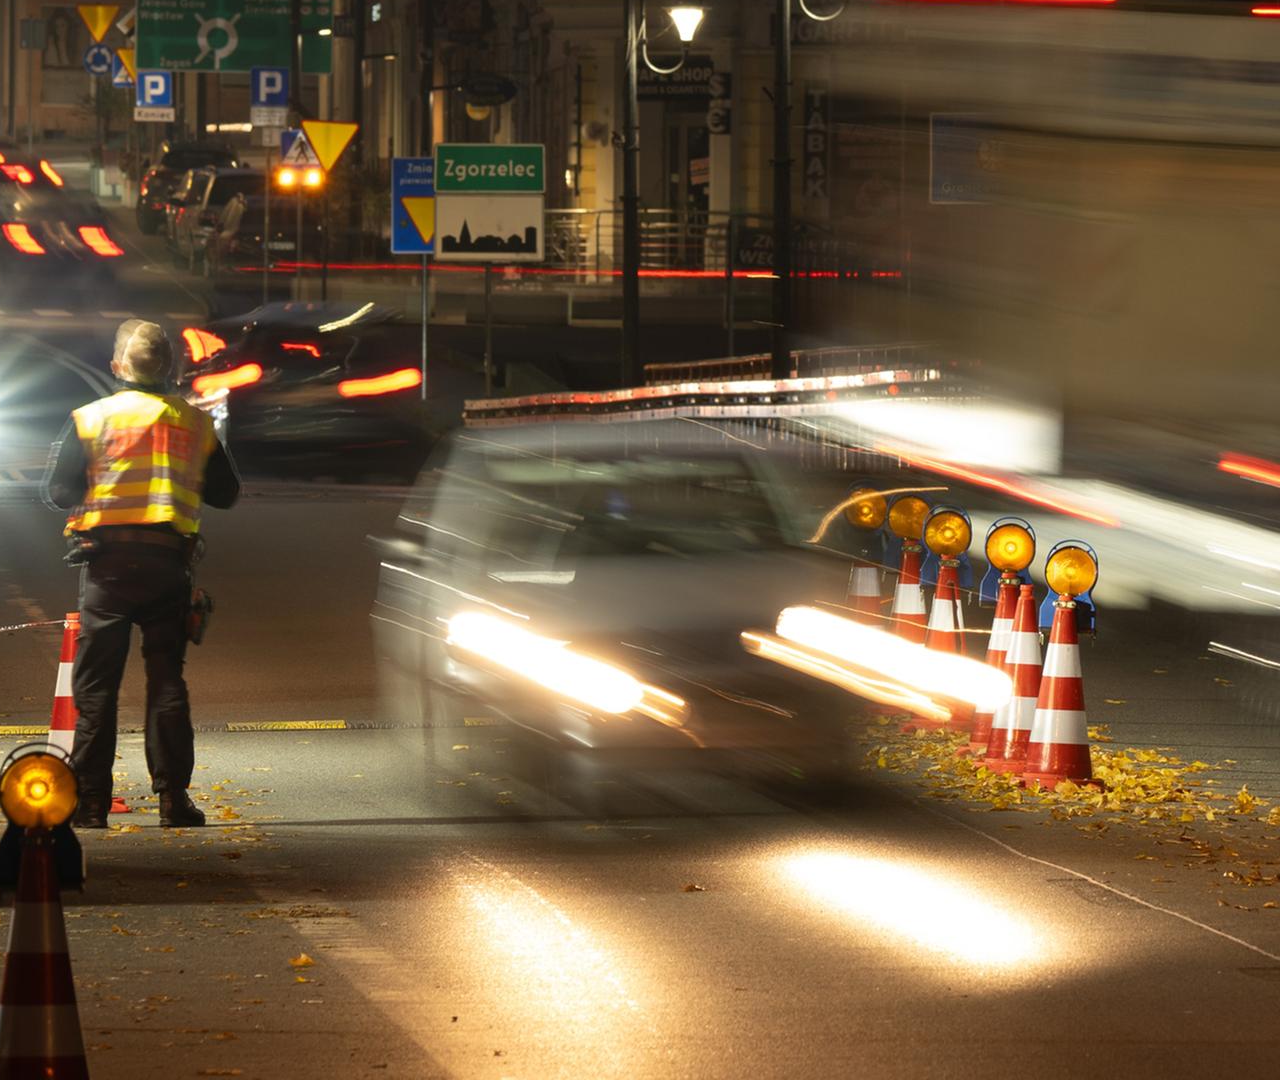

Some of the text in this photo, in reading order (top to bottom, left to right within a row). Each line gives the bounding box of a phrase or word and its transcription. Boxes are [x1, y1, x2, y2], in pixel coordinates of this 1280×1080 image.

[259, 71, 283, 103] P
[672, 67, 712, 82] SHOP
[144, 75, 165, 104] P
[806, 89, 826, 198] TABAK
[444, 160, 536, 182] Zgorzelec
